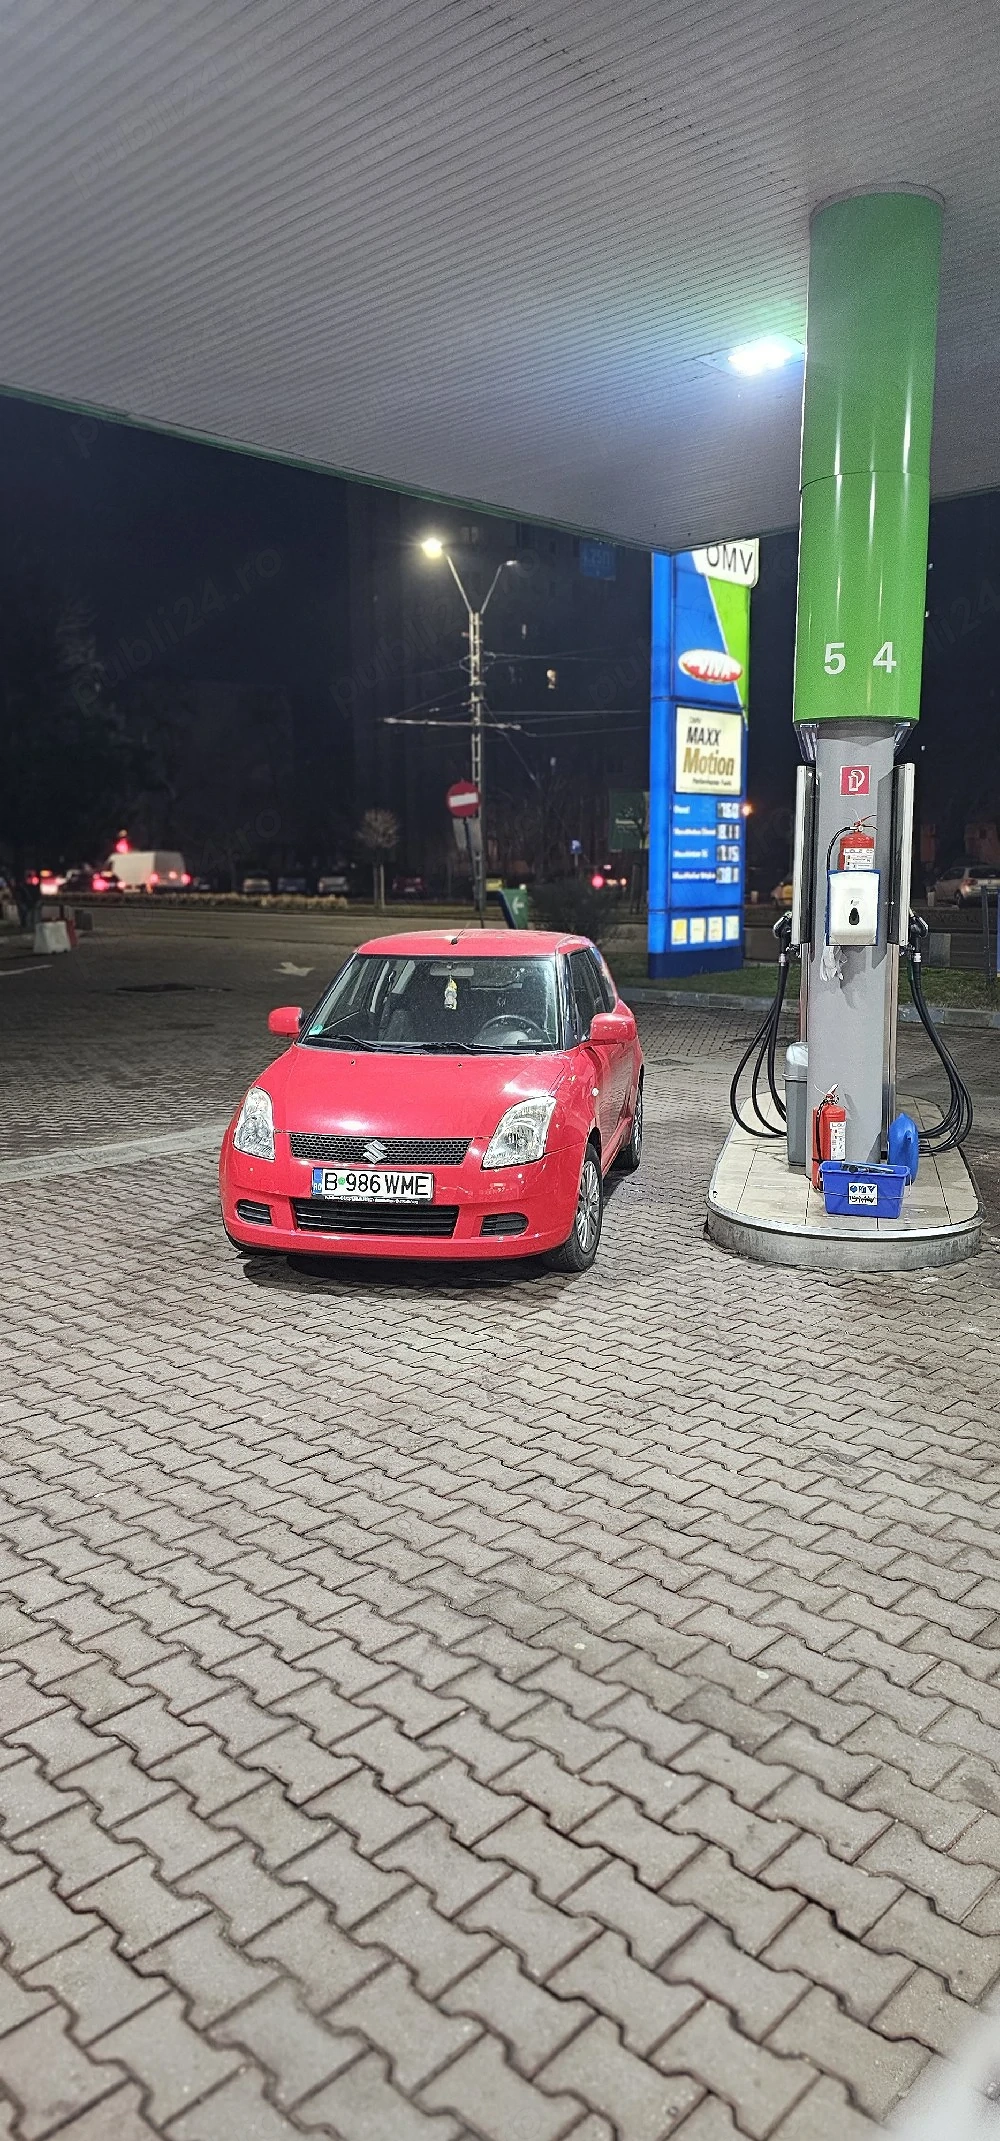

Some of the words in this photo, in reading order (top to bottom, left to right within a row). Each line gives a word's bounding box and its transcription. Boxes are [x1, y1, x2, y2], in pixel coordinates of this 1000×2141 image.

[706, 545, 753, 575] OMV
[823, 641, 846, 675] 5
[872, 641, 897, 673] 4
[686, 726, 722, 746] MAXX
[682, 747, 735, 776] Motion
[324, 1172, 338, 1191] B
[345, 1173, 381, 1193] 986
[384, 1174, 430, 1196] WME
